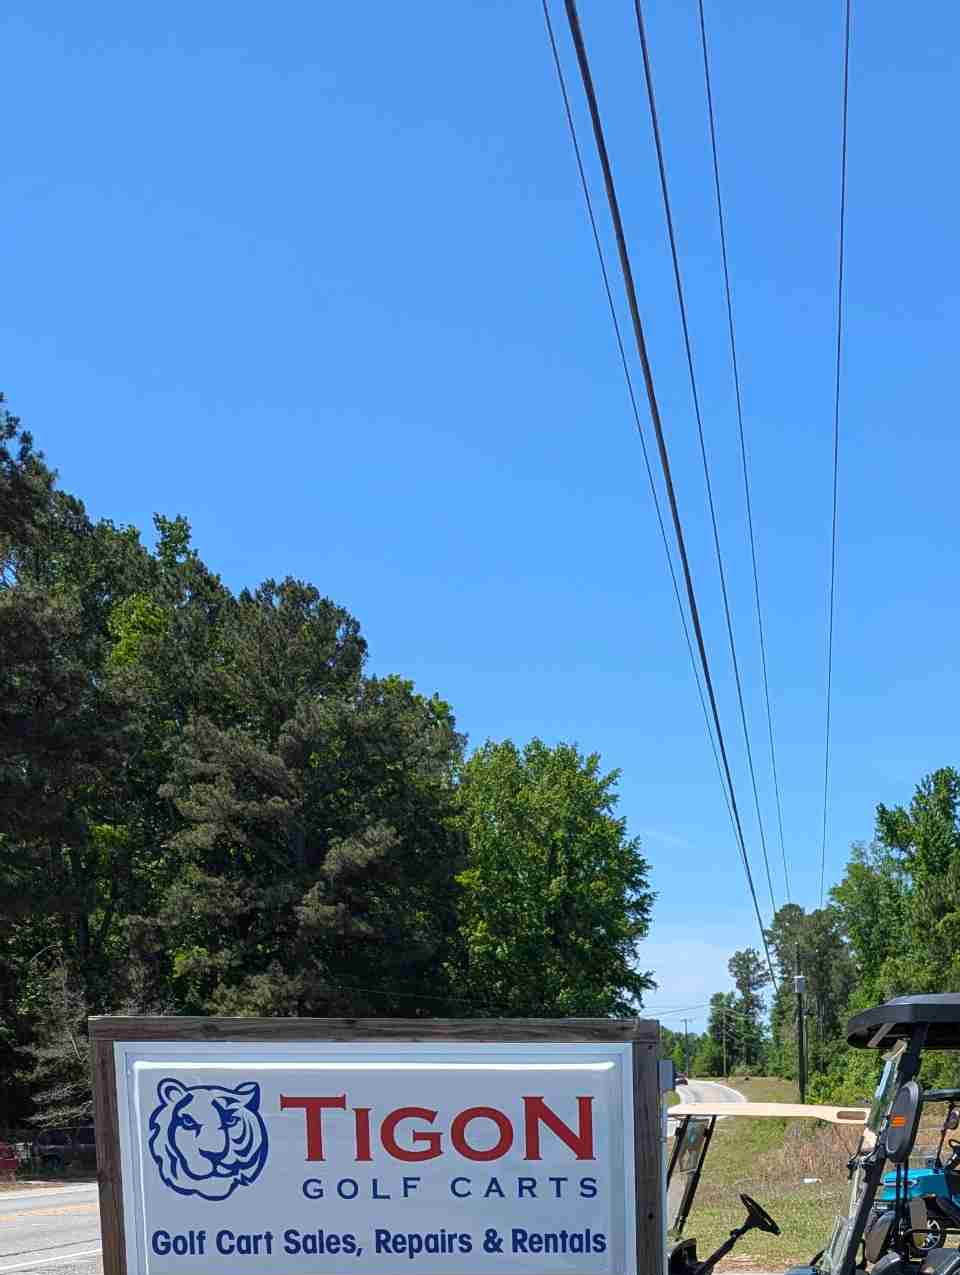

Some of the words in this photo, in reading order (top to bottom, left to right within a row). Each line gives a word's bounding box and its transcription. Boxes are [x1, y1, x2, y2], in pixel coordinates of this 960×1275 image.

[279, 1093, 597, 1163] TIGON
[302, 1177, 421, 1200] GOLF
[450, 1176, 598, 1199] CARTS
[151, 1229, 207, 1256] Golf
[215, 1229, 274, 1256] Cart
[283, 1228, 363, 1258] Sales,
[374, 1228, 473, 1260] Repairs
[482, 1228, 504, 1254] &
[511, 1228, 607, 1254] Rentals
